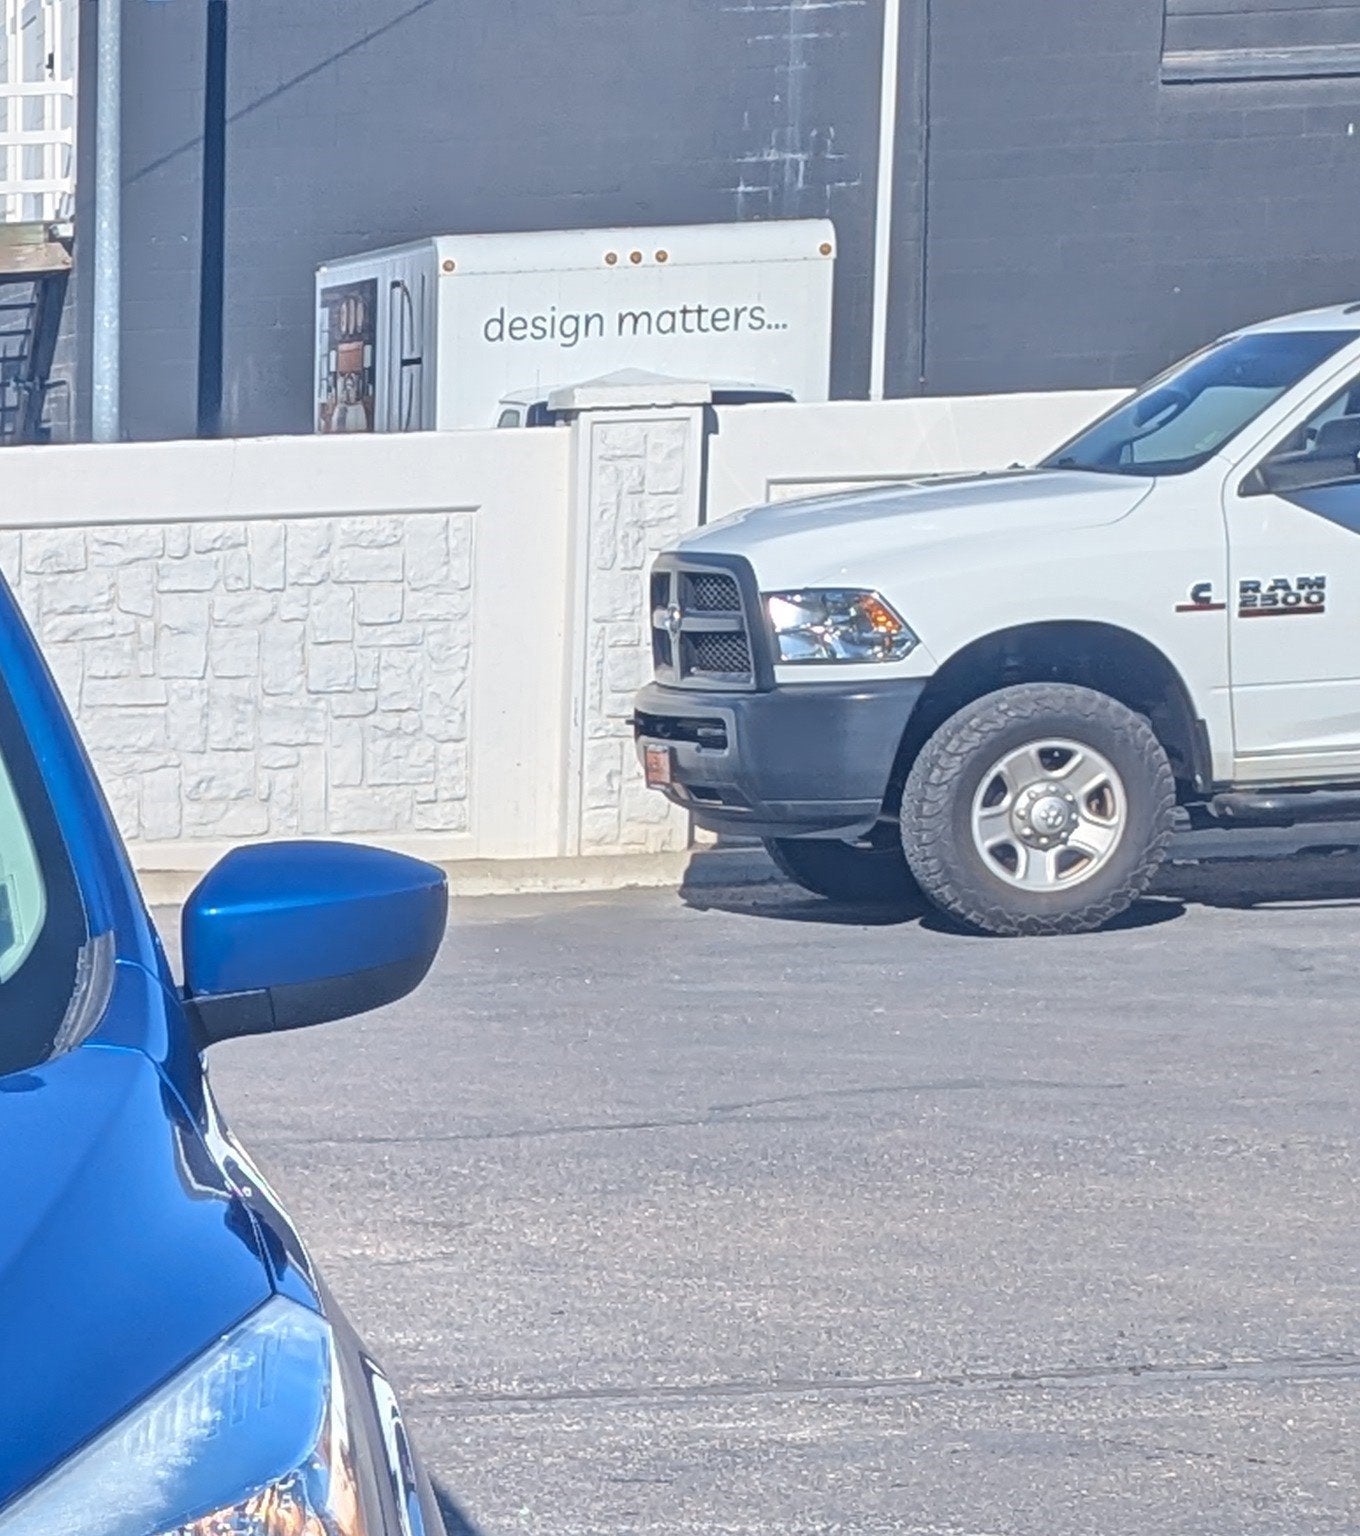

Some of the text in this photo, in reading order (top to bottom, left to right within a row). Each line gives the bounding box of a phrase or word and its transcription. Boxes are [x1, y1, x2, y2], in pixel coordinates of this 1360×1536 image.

[482, 302, 789, 347] design matters...
[1238, 576, 1326, 594] RAM
[1238, 591, 1326, 608] 2500
